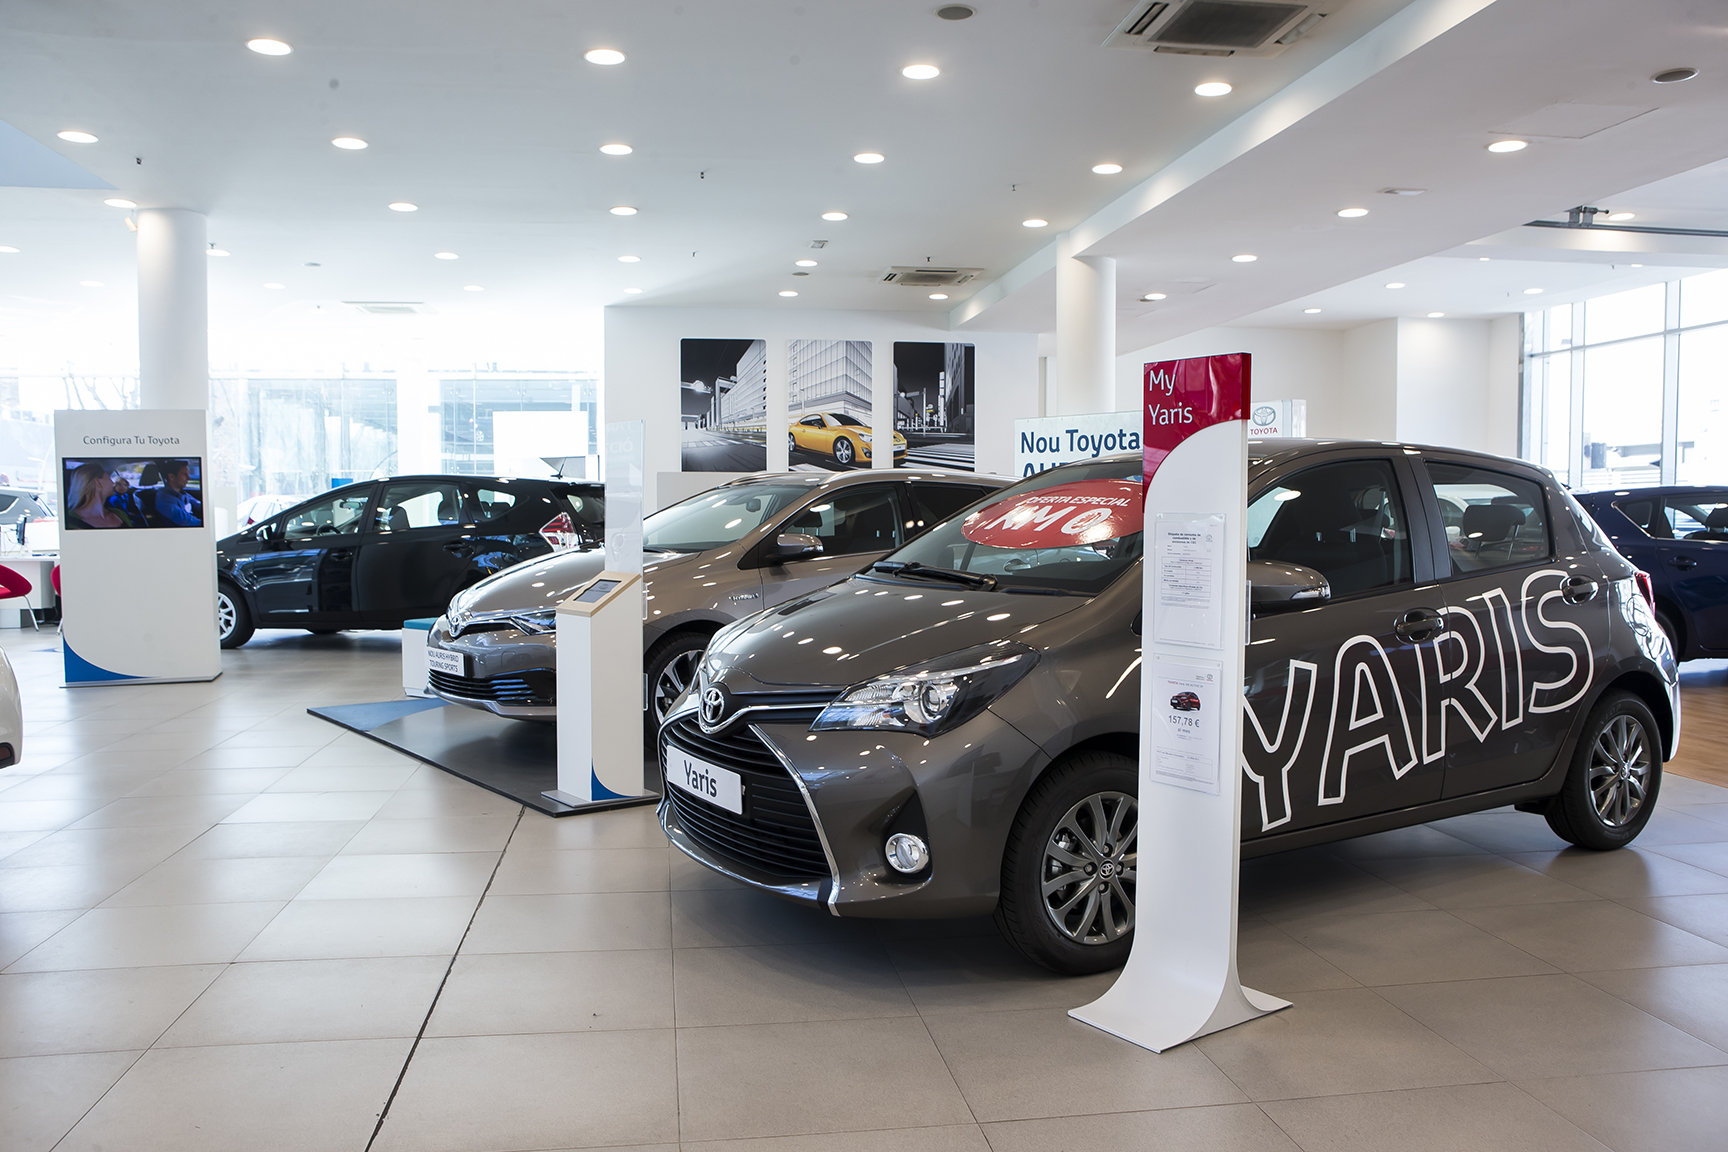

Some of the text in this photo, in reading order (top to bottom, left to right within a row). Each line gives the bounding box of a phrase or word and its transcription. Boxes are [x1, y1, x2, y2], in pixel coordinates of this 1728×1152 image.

[1149, 368, 1176, 396] My
[1148, 402, 1193, 425] Yaris
[82, 435, 180, 447] Configura Tu Toyota
[1021, 428, 1141, 458] Nou Toyota
[1250, 427, 1278, 436] TOYOTA
[1026, 496, 1132, 508] OFERTA ESPECIAL
[1242, 569, 1594, 833] YARIS
[1168, 714, 1200, 728] 157,78 €
[683, 759, 717, 798] Yaris
